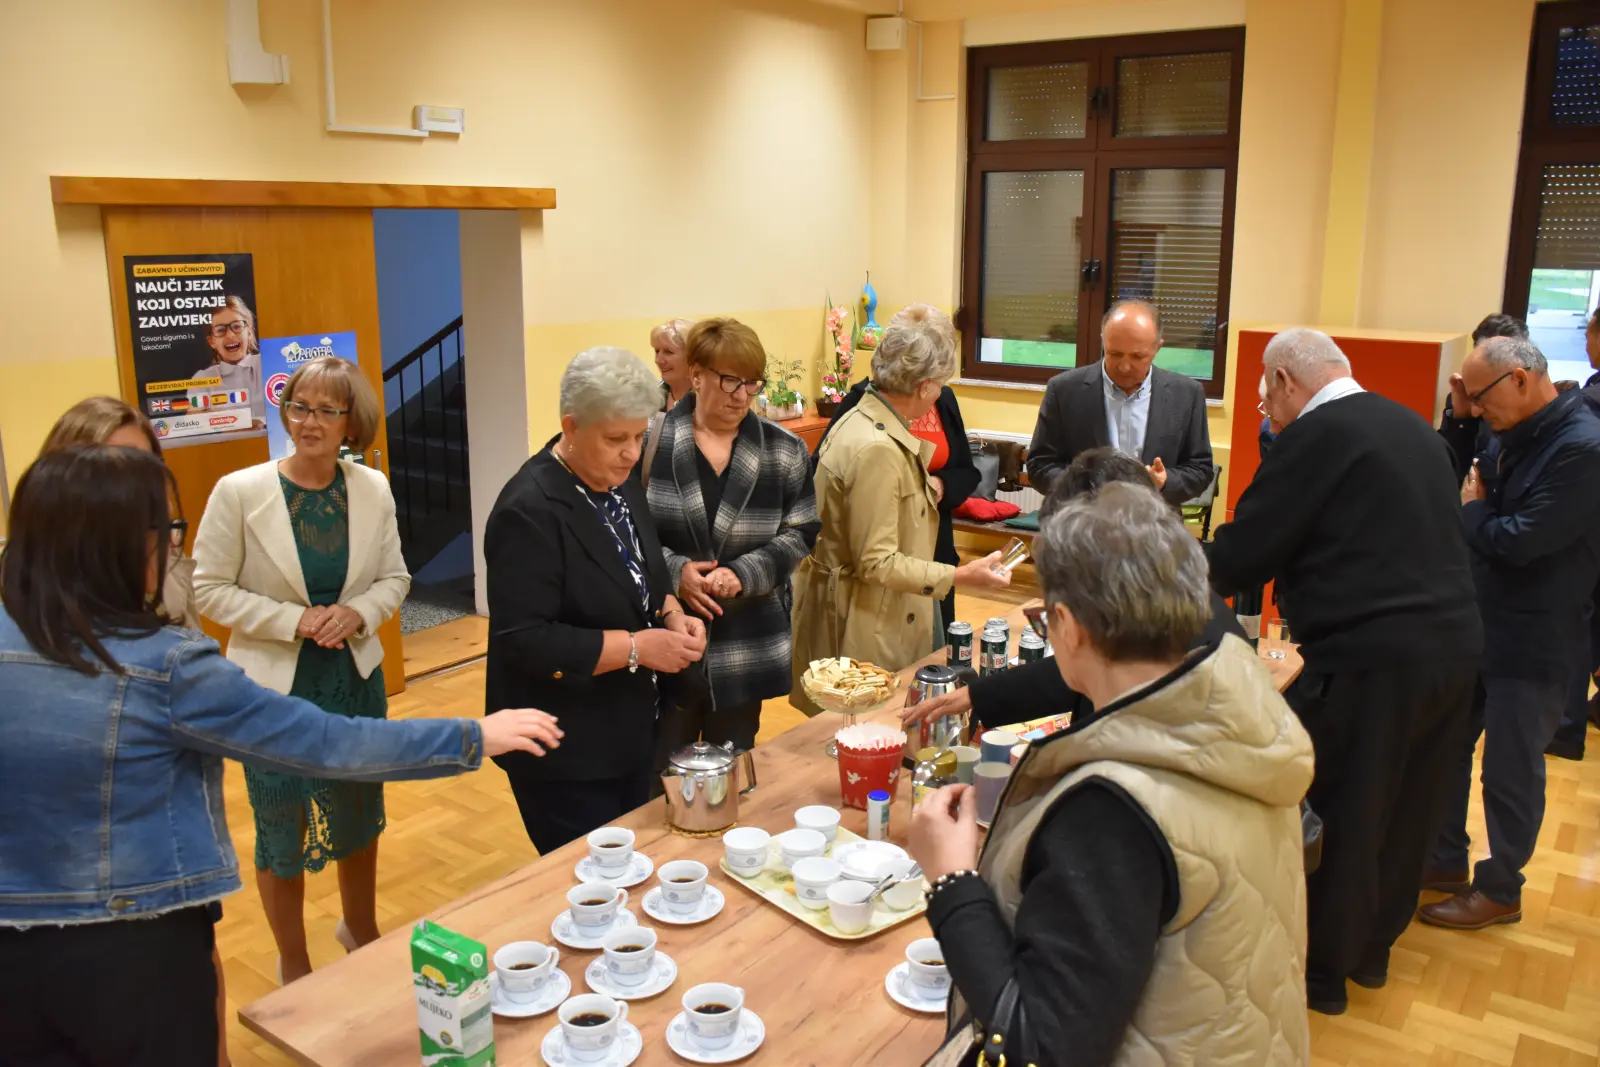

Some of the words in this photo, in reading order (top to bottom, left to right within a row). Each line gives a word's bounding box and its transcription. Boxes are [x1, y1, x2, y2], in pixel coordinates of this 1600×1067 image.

[135, 278, 182, 293] NAUČI
[185, 280, 224, 292] JEZIK
[137, 299, 170, 311] KOJI
[174, 296, 226, 309] OSTAJE
[139, 314, 212, 328] ZAUVIJEK!
[174, 420, 200, 428] didasko
[418, 998, 452, 1020] MLIJEKO
